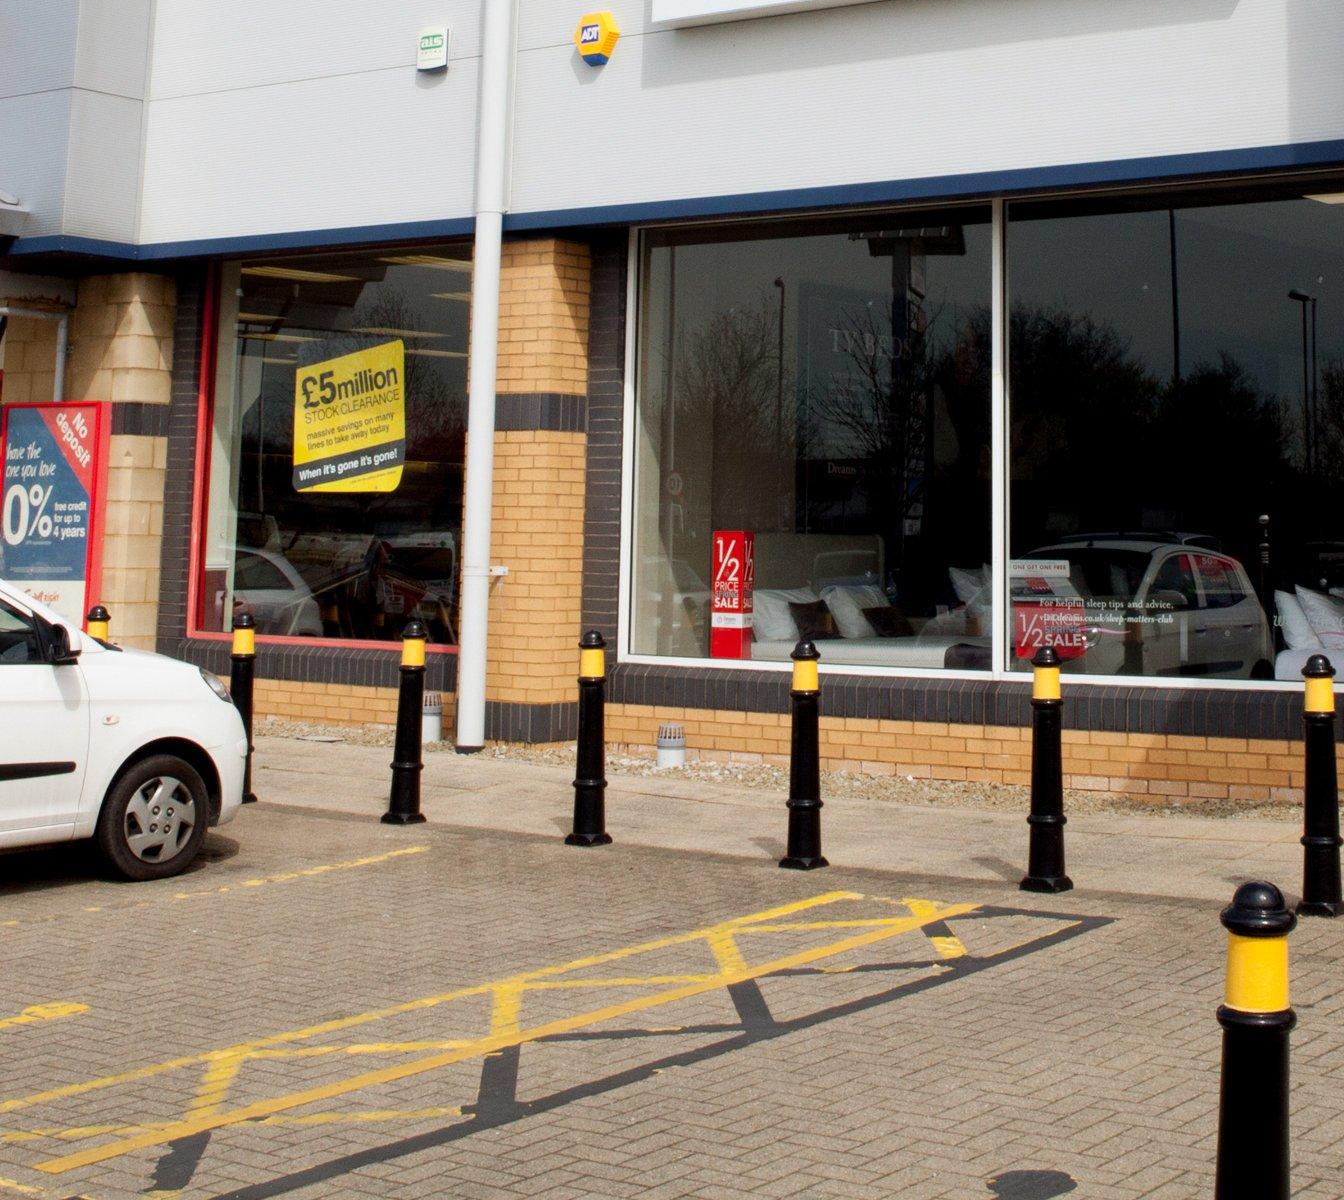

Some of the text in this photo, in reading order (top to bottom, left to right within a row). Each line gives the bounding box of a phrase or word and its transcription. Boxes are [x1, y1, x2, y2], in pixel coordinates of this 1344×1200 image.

[581, 25, 599, 42] ADT
[304, 389, 400, 424] STOCK CLEARANCE
[72, 412, 88, 438] No
[306, 411, 395, 440] massive savings on many
[56, 413, 91, 468] deposit
[307, 423, 390, 451] lines to take away today
[6, 441, 42, 460] have the
[6, 460, 57, 482] one you love
[298, 447, 398, 481] When it's gone it's gone!
[3, 484, 53, 545] 0%
[54, 501, 87, 511] free credit
[54, 514, 81, 524] for up to
[53, 526, 86, 541] 4 years
[714, 581, 739, 591] PRICE
[714, 597, 739, 608] SALE
[1040, 598, 1174, 610] For helpful sleep tips and advice,
[1043, 613, 1081, 625] PRICE
[1044, 633, 1082, 647] SALE
